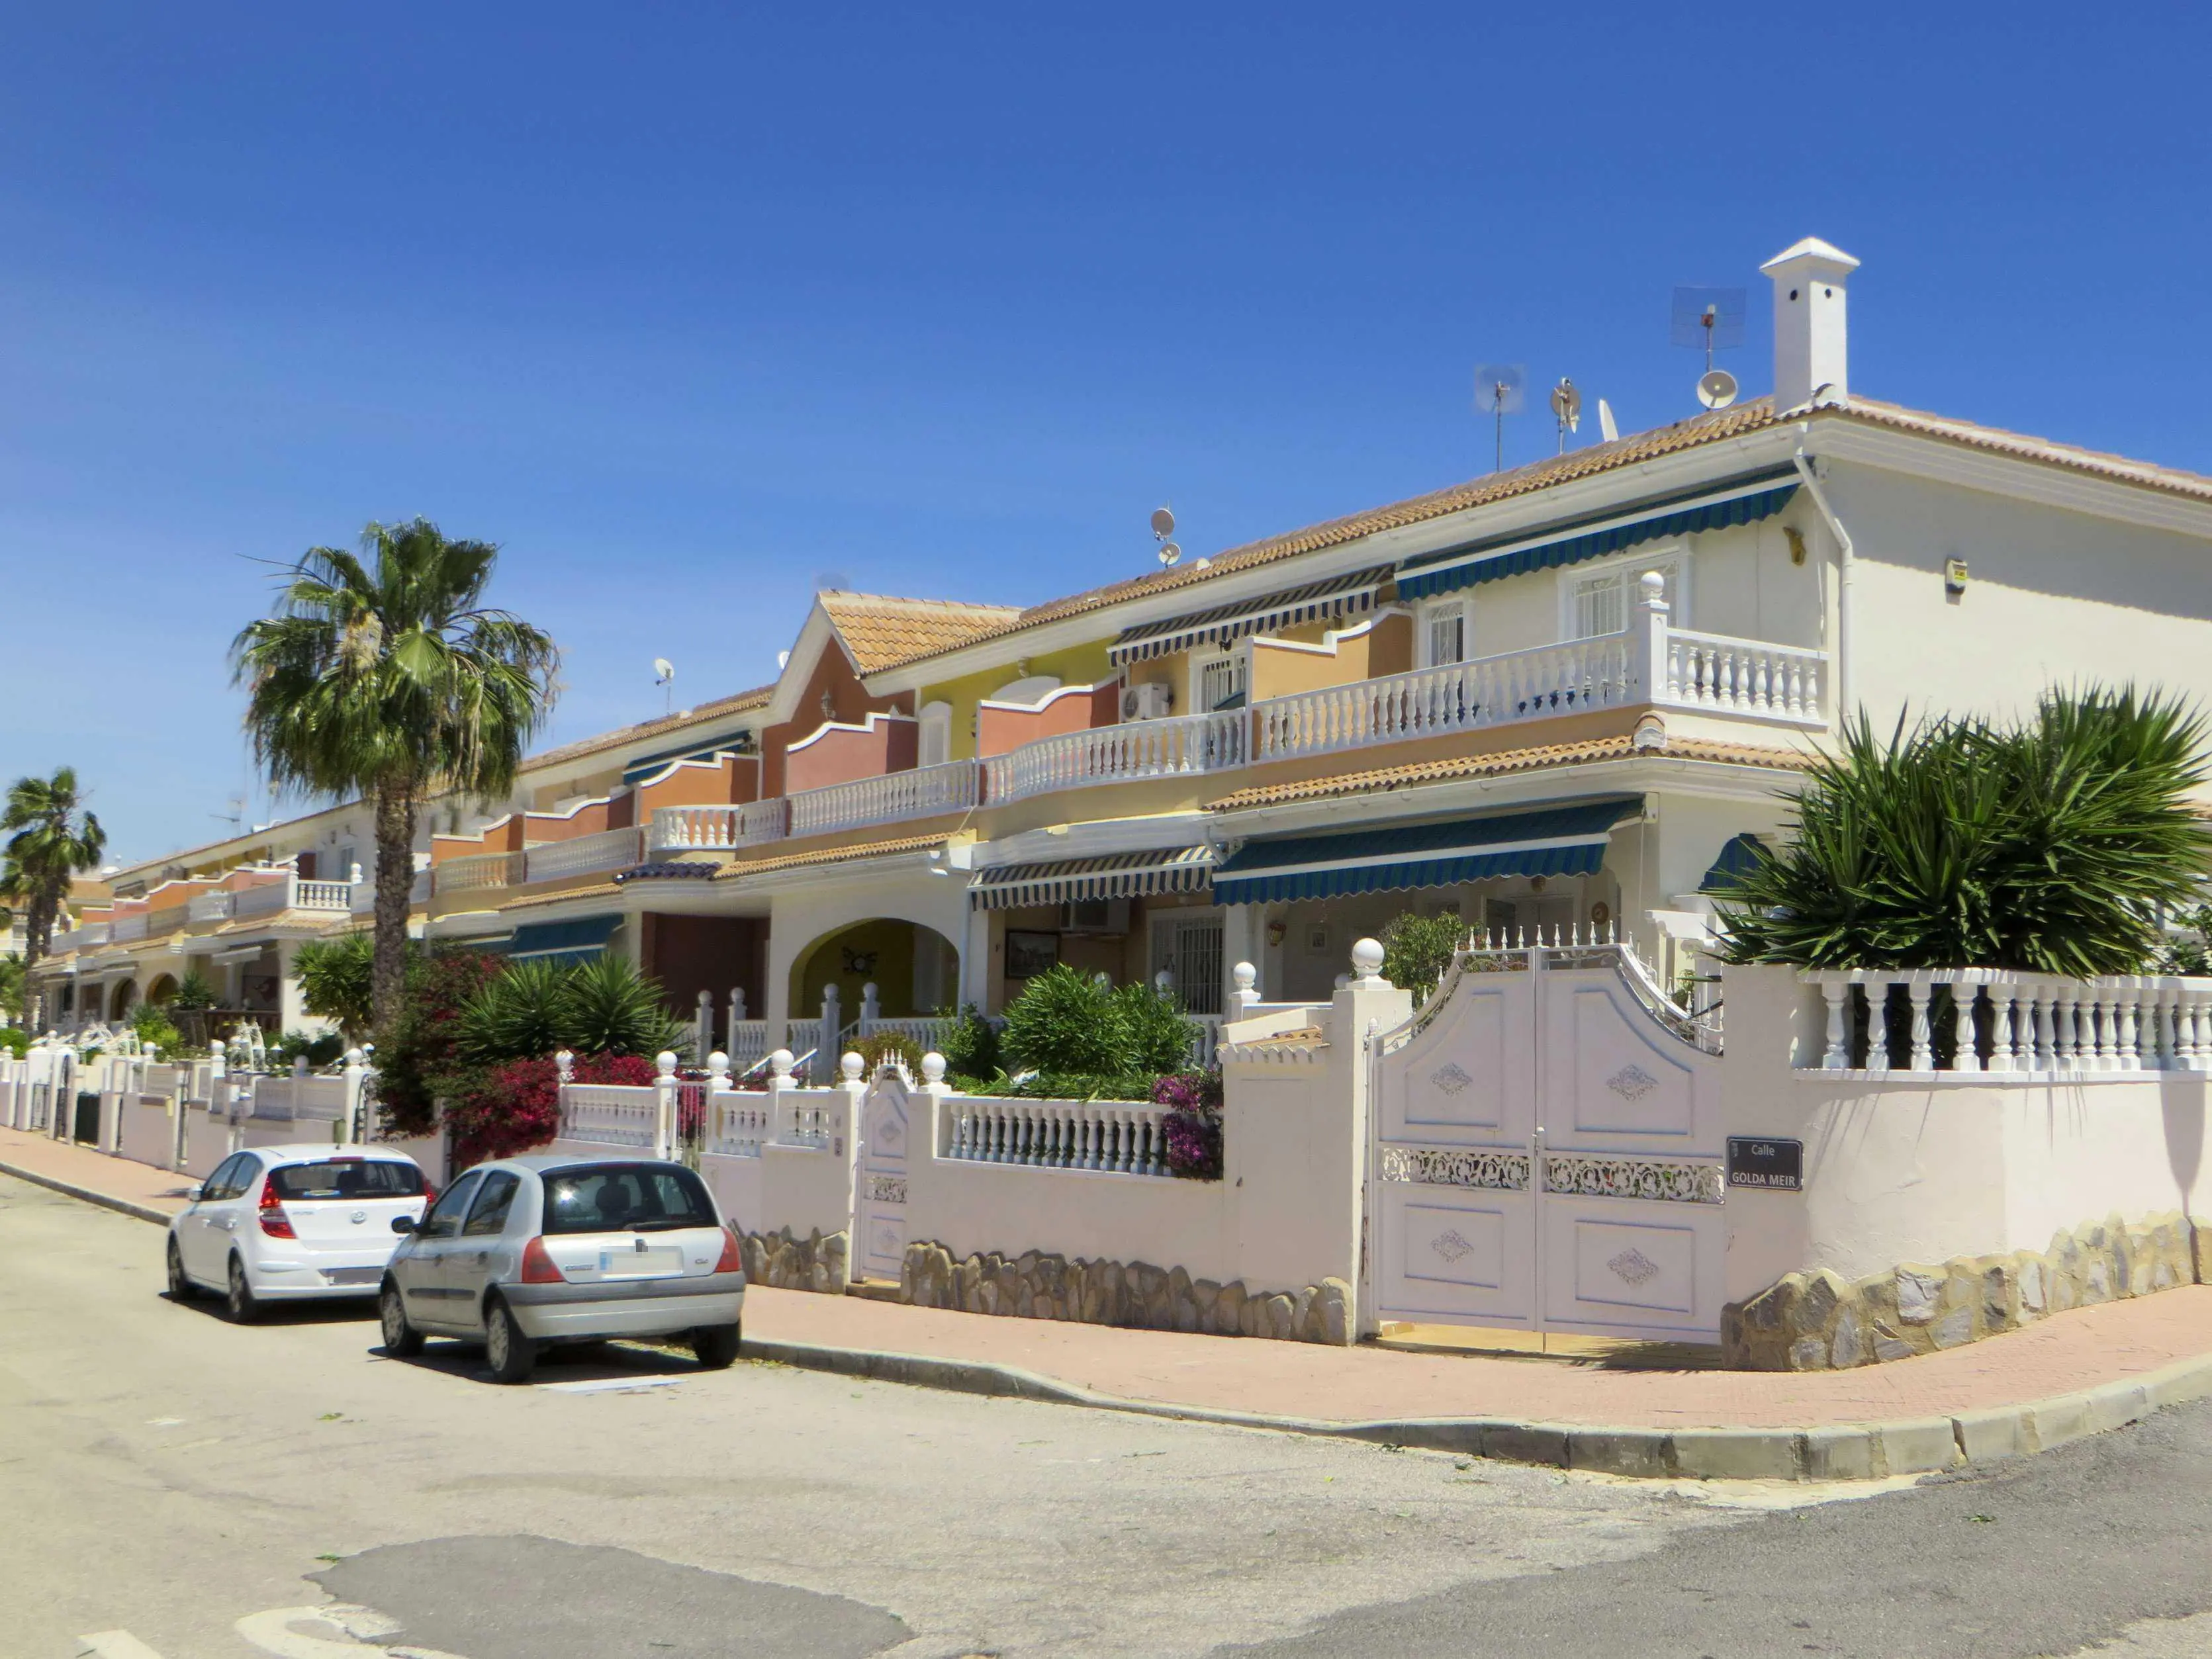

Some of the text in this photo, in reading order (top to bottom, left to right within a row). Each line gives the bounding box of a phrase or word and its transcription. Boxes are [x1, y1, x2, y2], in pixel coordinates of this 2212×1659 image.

[1751, 1145, 1775, 1155] Calle
[1732, 1172, 1796, 1187] GOLDA MEIR
